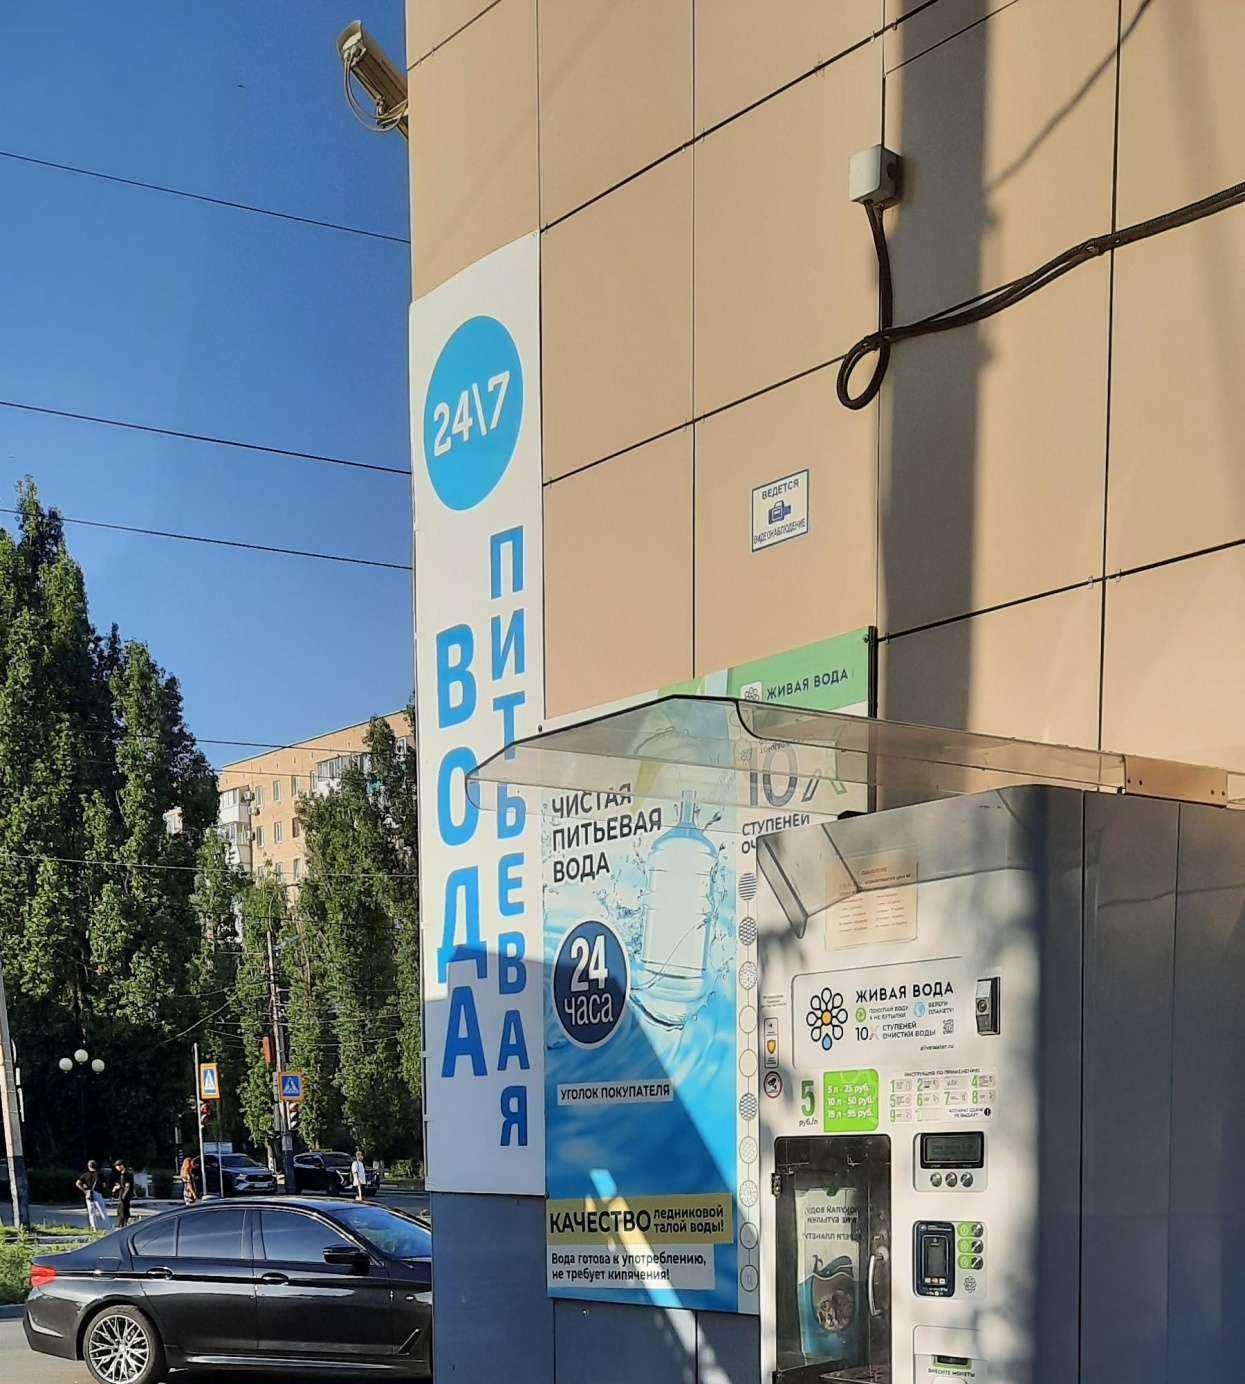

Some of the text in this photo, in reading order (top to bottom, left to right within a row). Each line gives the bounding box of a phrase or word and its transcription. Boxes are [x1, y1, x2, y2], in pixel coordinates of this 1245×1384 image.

[433, 370, 511, 458] 24\7
[761, 478, 800, 500] ВЕДЕТСЯ
[766, 668, 849, 701] ЖИВАЯ ВОДА
[551, 783, 632, 819] ЧИСТАЯ
[490, 524, 530, 1147] ПИТЬЕВАЯ
[552, 807, 662, 852] ПИТЬЕВАЯ
[435, 623, 488, 1079] ВОДА
[553, 851, 610, 883] ВОДА
[570, 934, 609, 992] 24
[855, 981, 954, 1004] ЖИВАЯ ВОДА
[564, 993, 614, 1027] часа
[882, 1020, 917, 1031] СТУПЕНЕЙ
[882, 1029, 936, 1040] ОЧИСТКИ ВОДЫ
[560, 1084, 671, 1101] УГОЛОК ПОКУПАТЕЛЯ
[801, 1080, 815, 1117] 5
[549, 1210, 652, 1234] КАЧЕСТВО
[653, 1204, 724, 1220] ледниковой
[653, 1219, 724, 1234] талой воды!
[551, 1252, 707, 1268] Вода готова к употреблению,
[551, 1268, 671, 1282] не требует кипячения!
